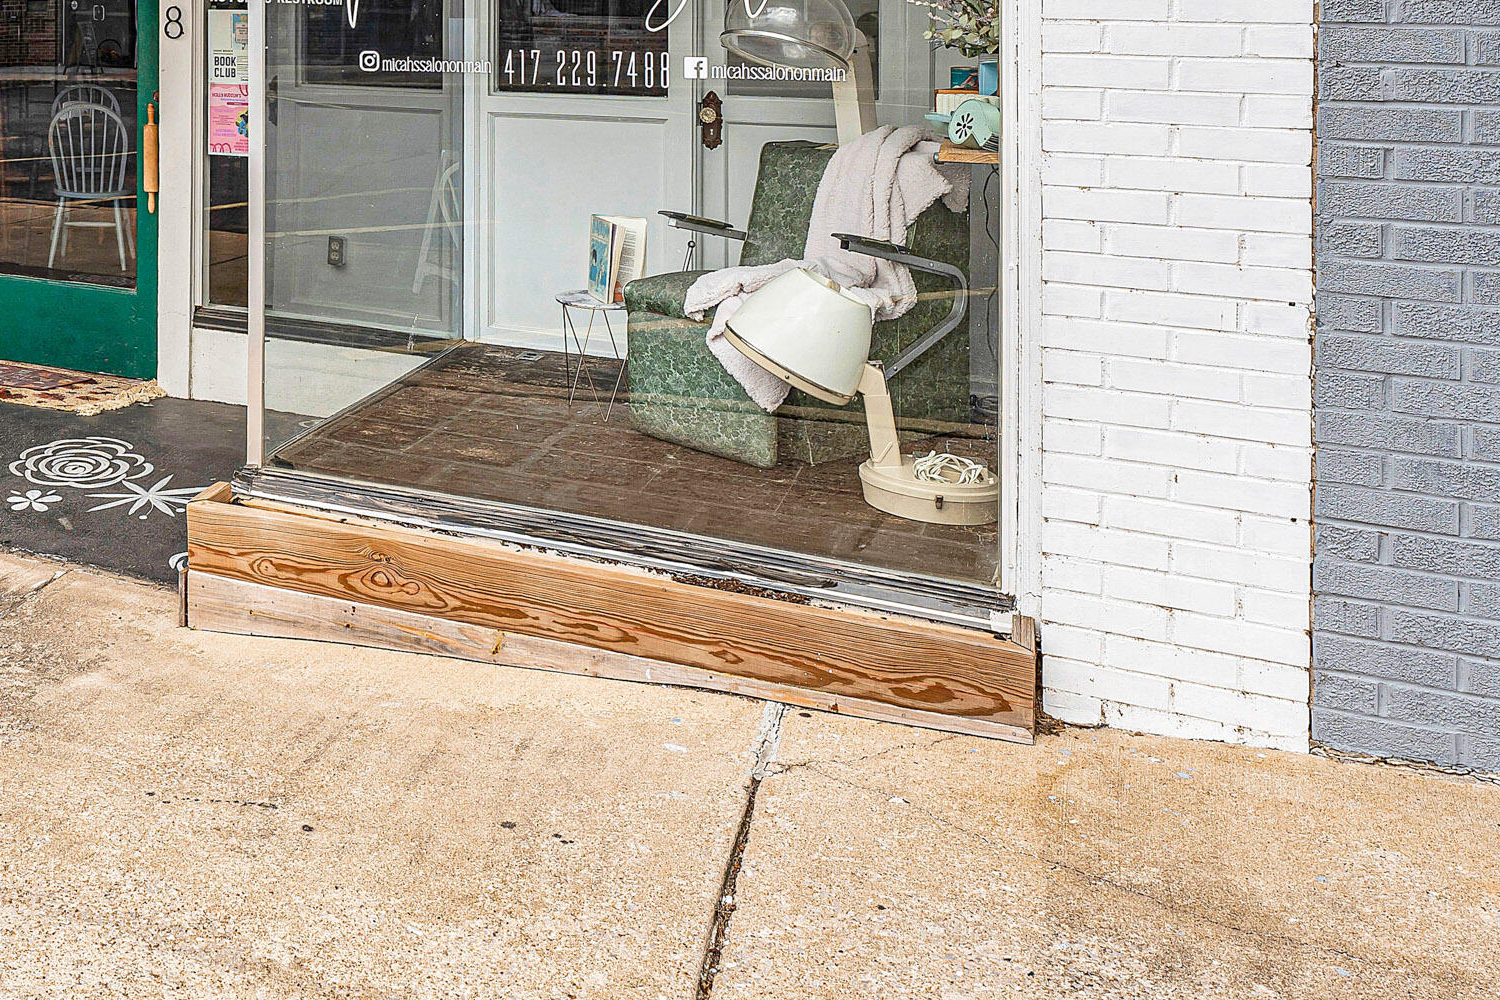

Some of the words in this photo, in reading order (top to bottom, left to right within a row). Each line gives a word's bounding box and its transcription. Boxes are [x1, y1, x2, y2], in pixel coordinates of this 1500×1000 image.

[214, 56, 237, 67] BOOK
[381, 56, 492, 74] micahssalononmain
[214, 67, 237, 78] CLUB
[710, 62, 847, 82] micahssalononmain
